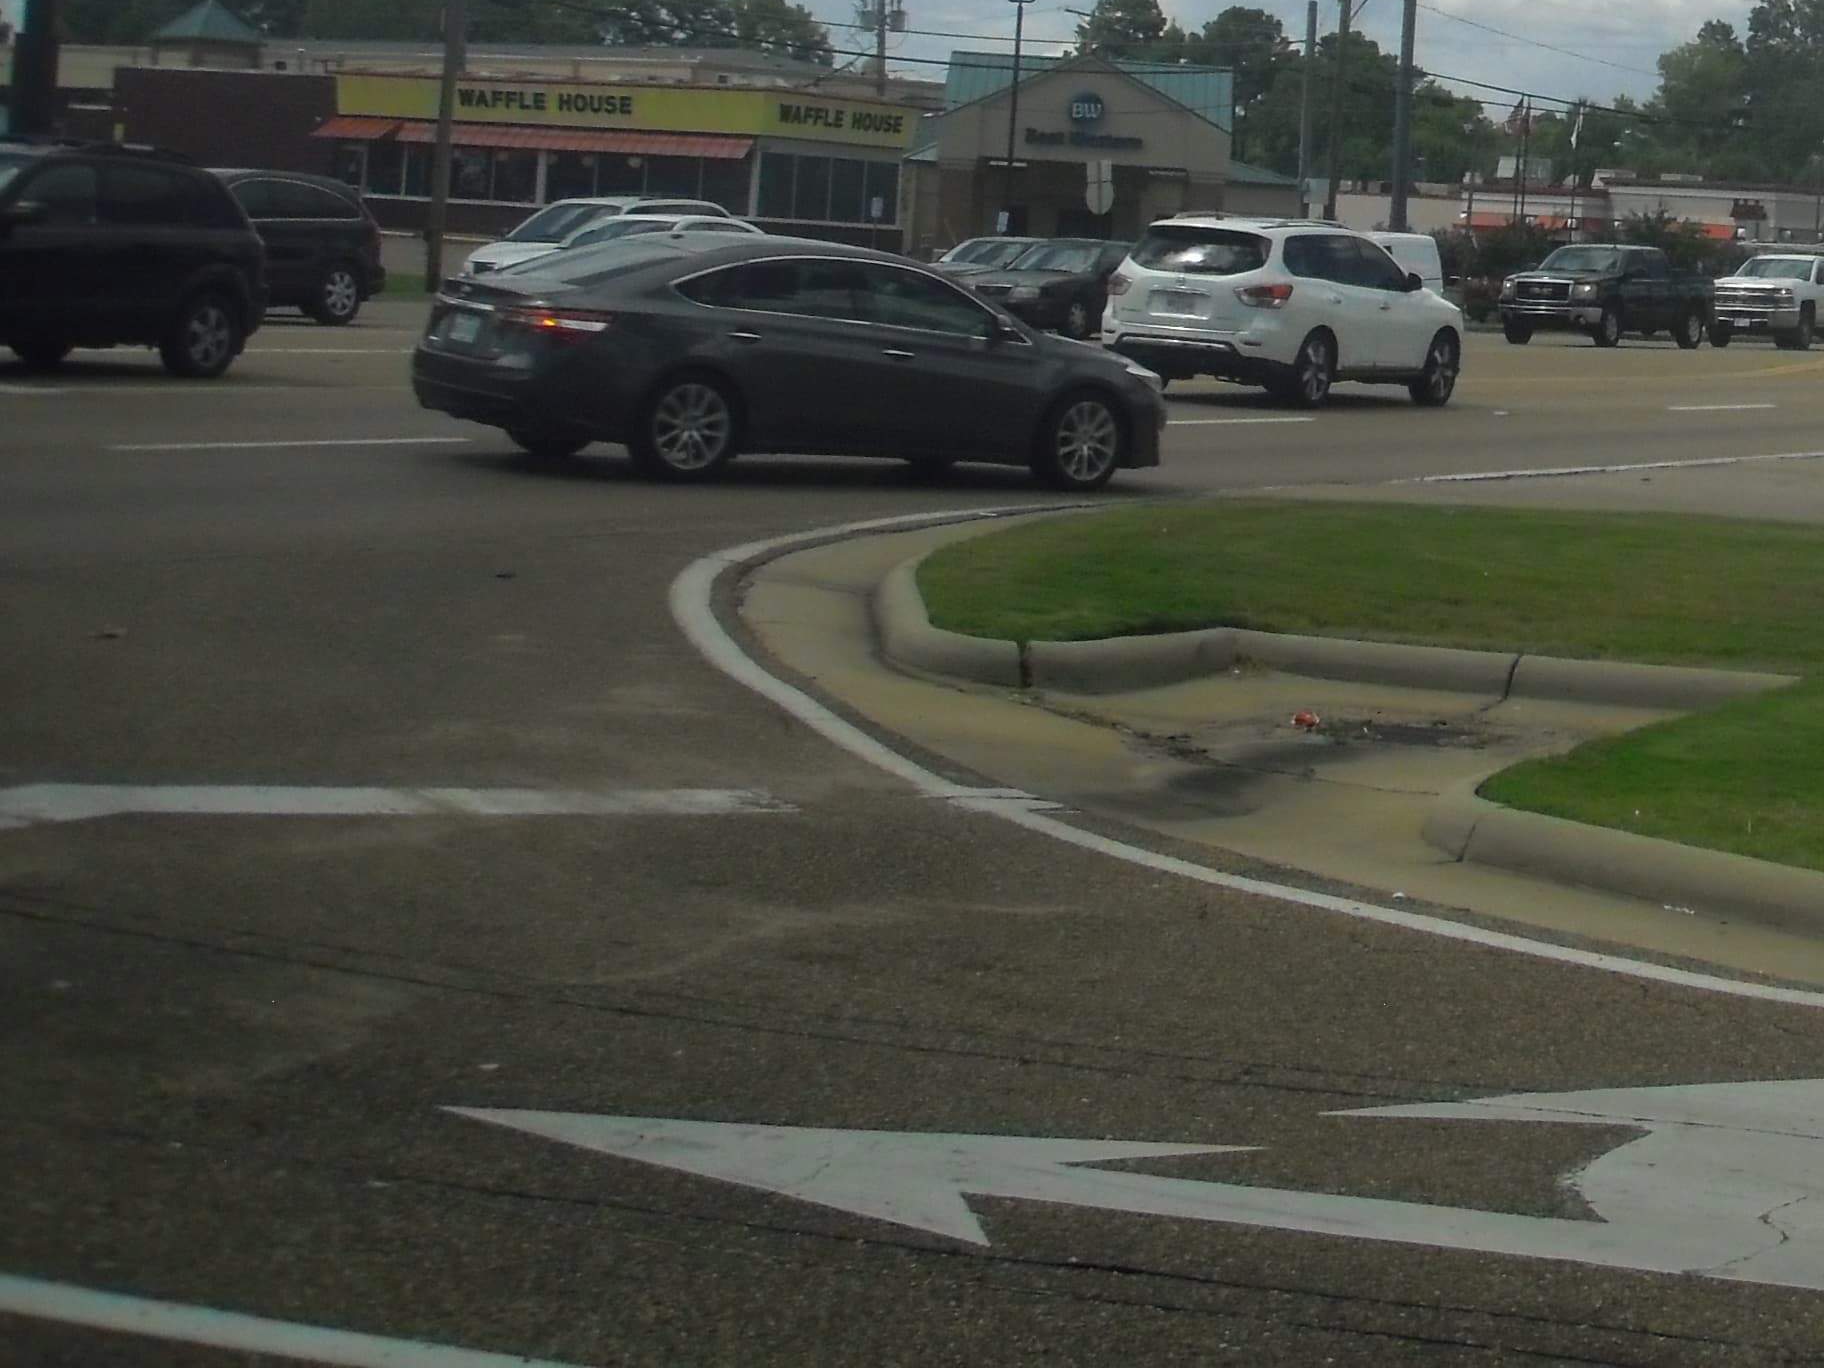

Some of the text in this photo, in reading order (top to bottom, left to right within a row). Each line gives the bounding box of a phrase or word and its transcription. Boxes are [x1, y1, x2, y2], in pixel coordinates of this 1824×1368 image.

[457, 87, 633, 116] WAFFLE HOUSE
[1071, 102, 1102, 119] BW
[778, 102, 904, 135] WAFFLE HOUSE
